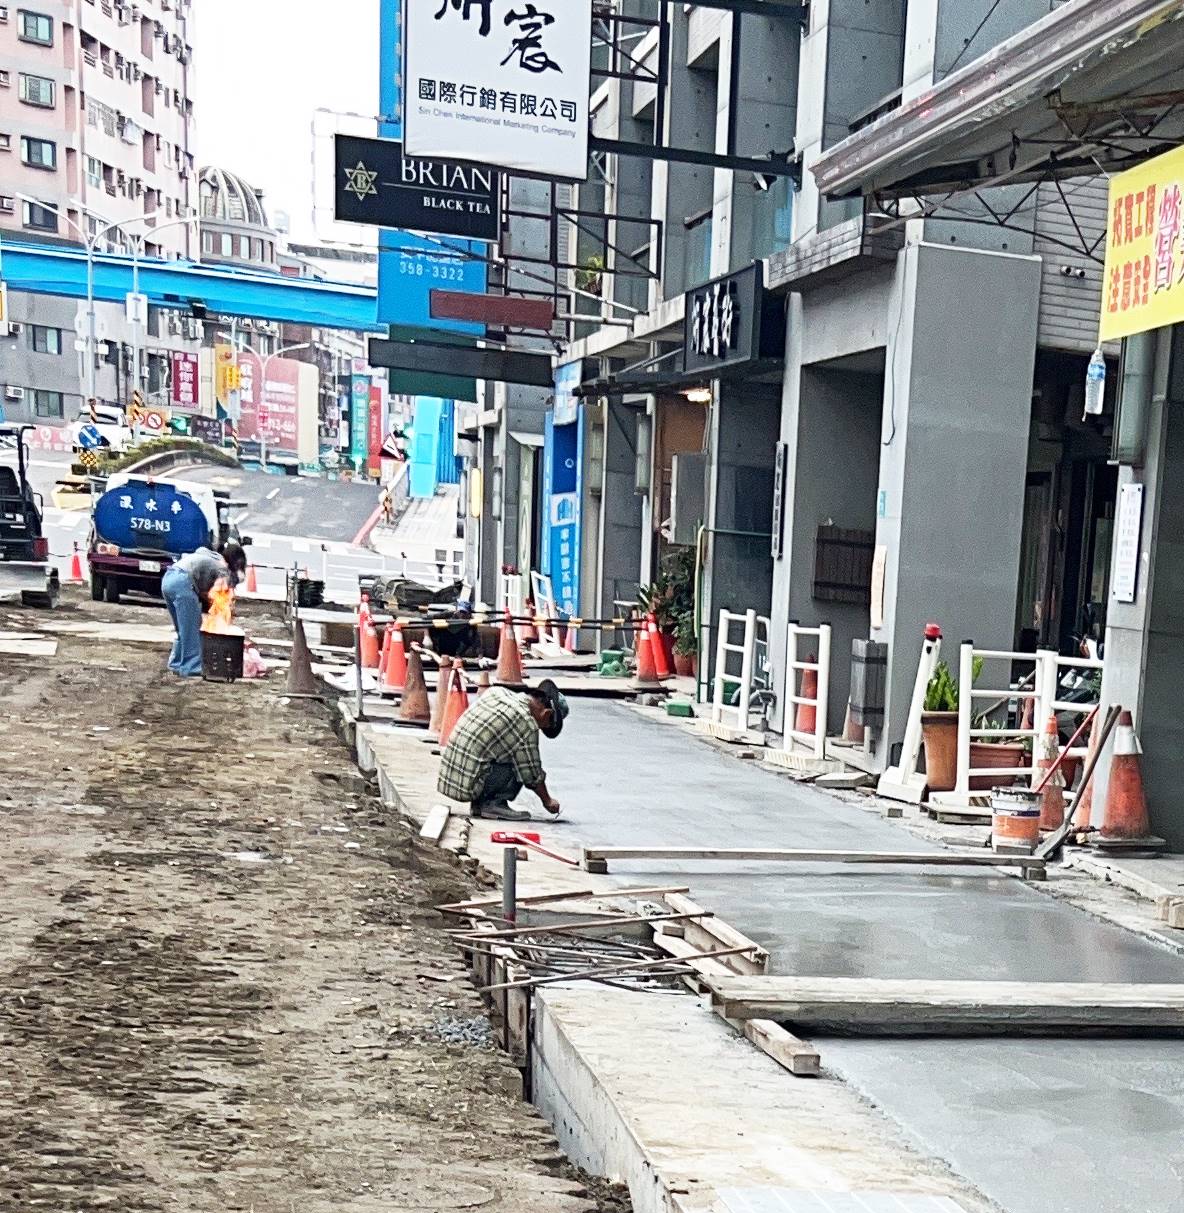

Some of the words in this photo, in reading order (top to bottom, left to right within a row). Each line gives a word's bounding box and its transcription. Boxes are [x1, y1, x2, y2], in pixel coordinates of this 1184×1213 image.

[418, 78, 577, 122] 國際行銷有限公司
[433, 108, 452, 118] Chen
[456, 112, 501, 125] International
[503, 119, 538, 133] Marketing
[541, 124, 576, 138] Company
[401, 159, 492, 192] BRIAN
[423, 196, 464, 211] BLACK
[467, 201, 491, 214] TEA
[130, 517, 171, 531] 578-N3
